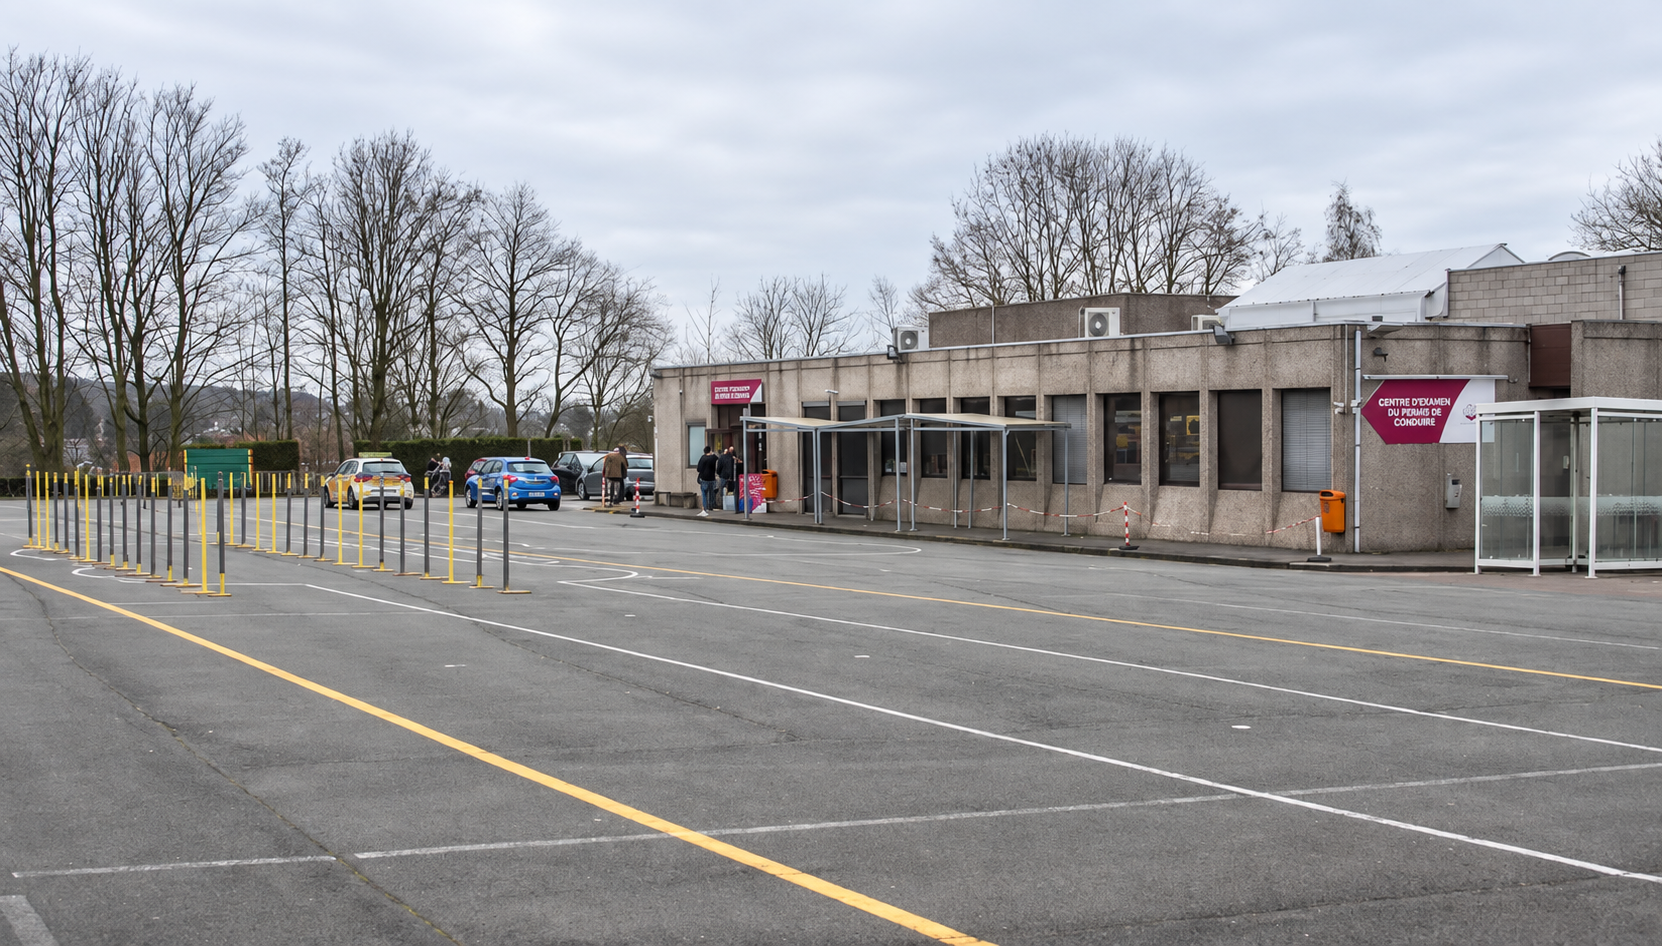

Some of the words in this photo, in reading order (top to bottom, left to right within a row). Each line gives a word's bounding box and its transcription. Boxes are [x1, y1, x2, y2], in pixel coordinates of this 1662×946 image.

[1378, 397, 1410, 407] CENTRE
[1411, 397, 1451, 406] D'EXAMEN
[1388, 408, 1400, 417] DU
[1431, 408, 1442, 416] DE
[1394, 418, 1436, 427] CONDUIRE
